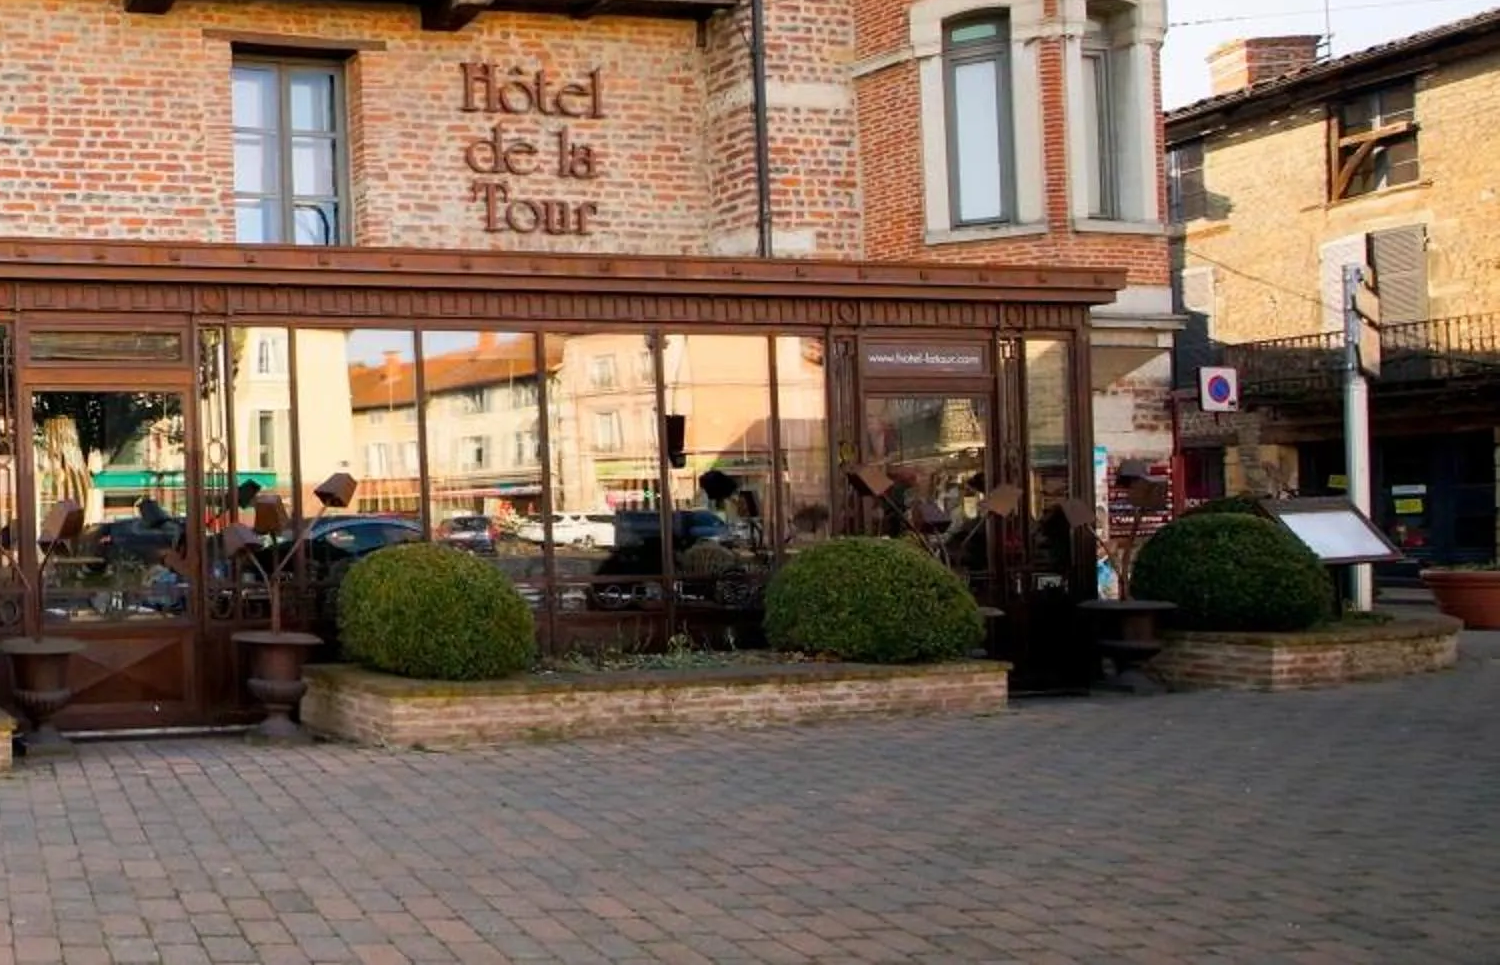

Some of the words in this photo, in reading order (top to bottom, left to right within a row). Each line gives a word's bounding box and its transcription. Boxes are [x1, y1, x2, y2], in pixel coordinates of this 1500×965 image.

[459, 61, 606, 119] Hôtel
[465, 122, 539, 176] de
[554, 124, 600, 180] la
[471, 179, 598, 236] Tour
